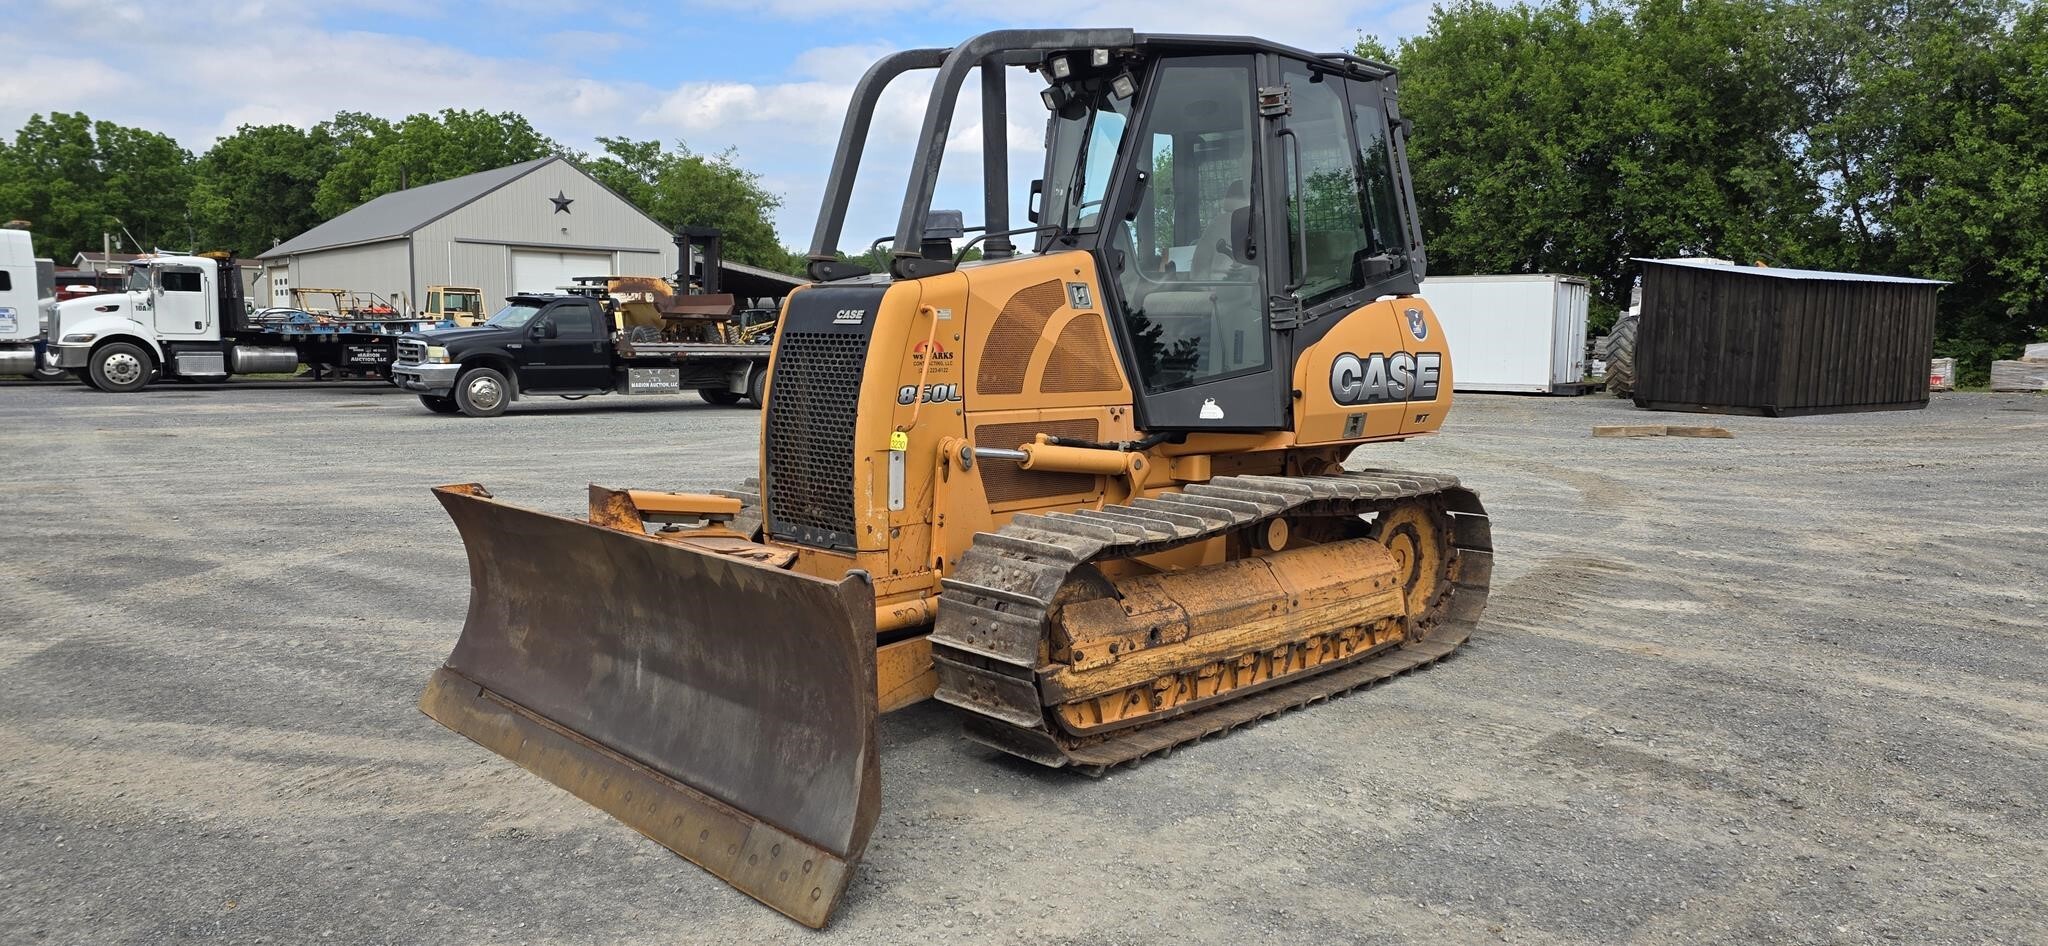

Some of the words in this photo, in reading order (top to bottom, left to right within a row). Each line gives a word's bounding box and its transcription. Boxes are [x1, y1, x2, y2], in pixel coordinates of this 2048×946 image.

[836, 309, 864, 319] CASE
[1330, 351, 1441, 405] CASE
[897, 383, 962, 404] 850L
[1414, 413, 1430, 423] WT
